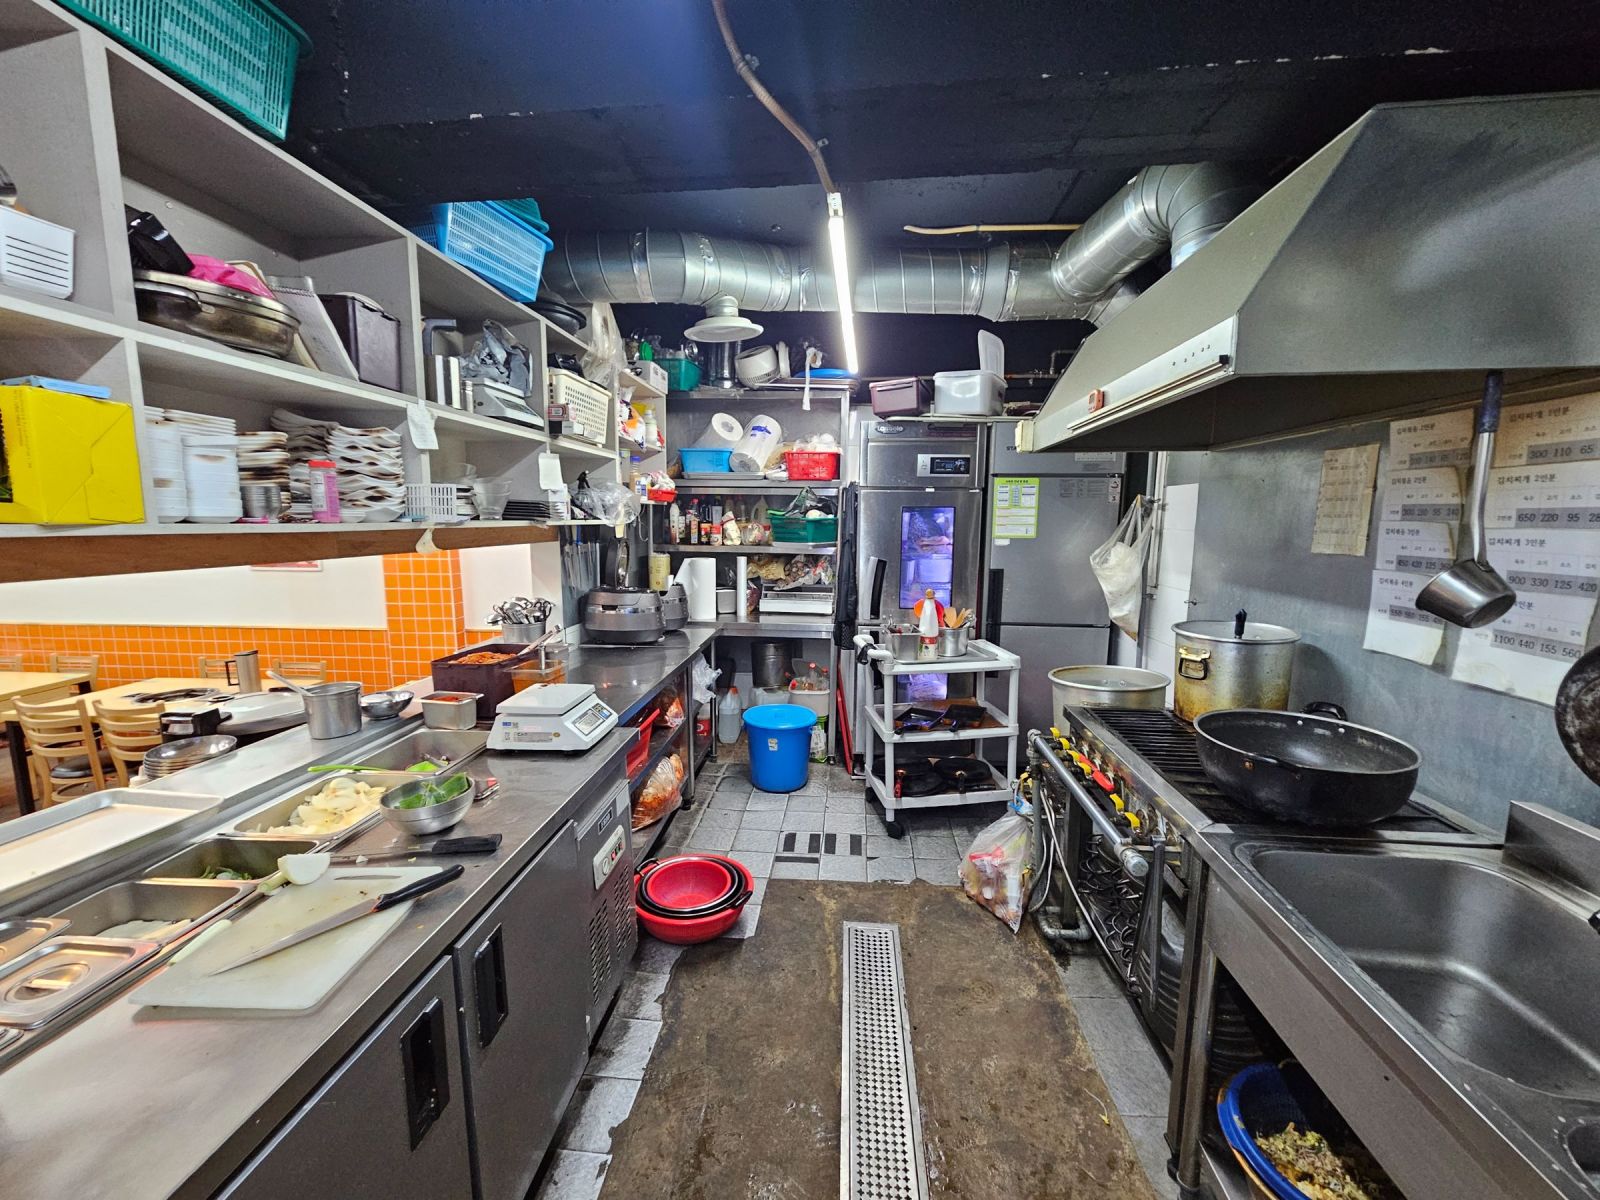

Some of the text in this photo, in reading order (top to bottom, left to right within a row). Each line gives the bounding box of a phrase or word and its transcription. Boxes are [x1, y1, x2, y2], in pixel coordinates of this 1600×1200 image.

[1552, 446, 1572, 458] 110
[1580, 444, 1594, 455] 65
[1518, 513, 1537, 522] 650
[1540, 513, 1559, 523] 220
[1567, 513, 1580, 522] 95
[1588, 512, 1600, 523] 28
[1508, 575, 1598, 593] 900 330 125 420
[1494, 634, 1515, 646] 1100
[1518, 639, 1535, 650] 440
[1540, 643, 1557, 655] 155
[1561, 647, 1582, 659] 560
